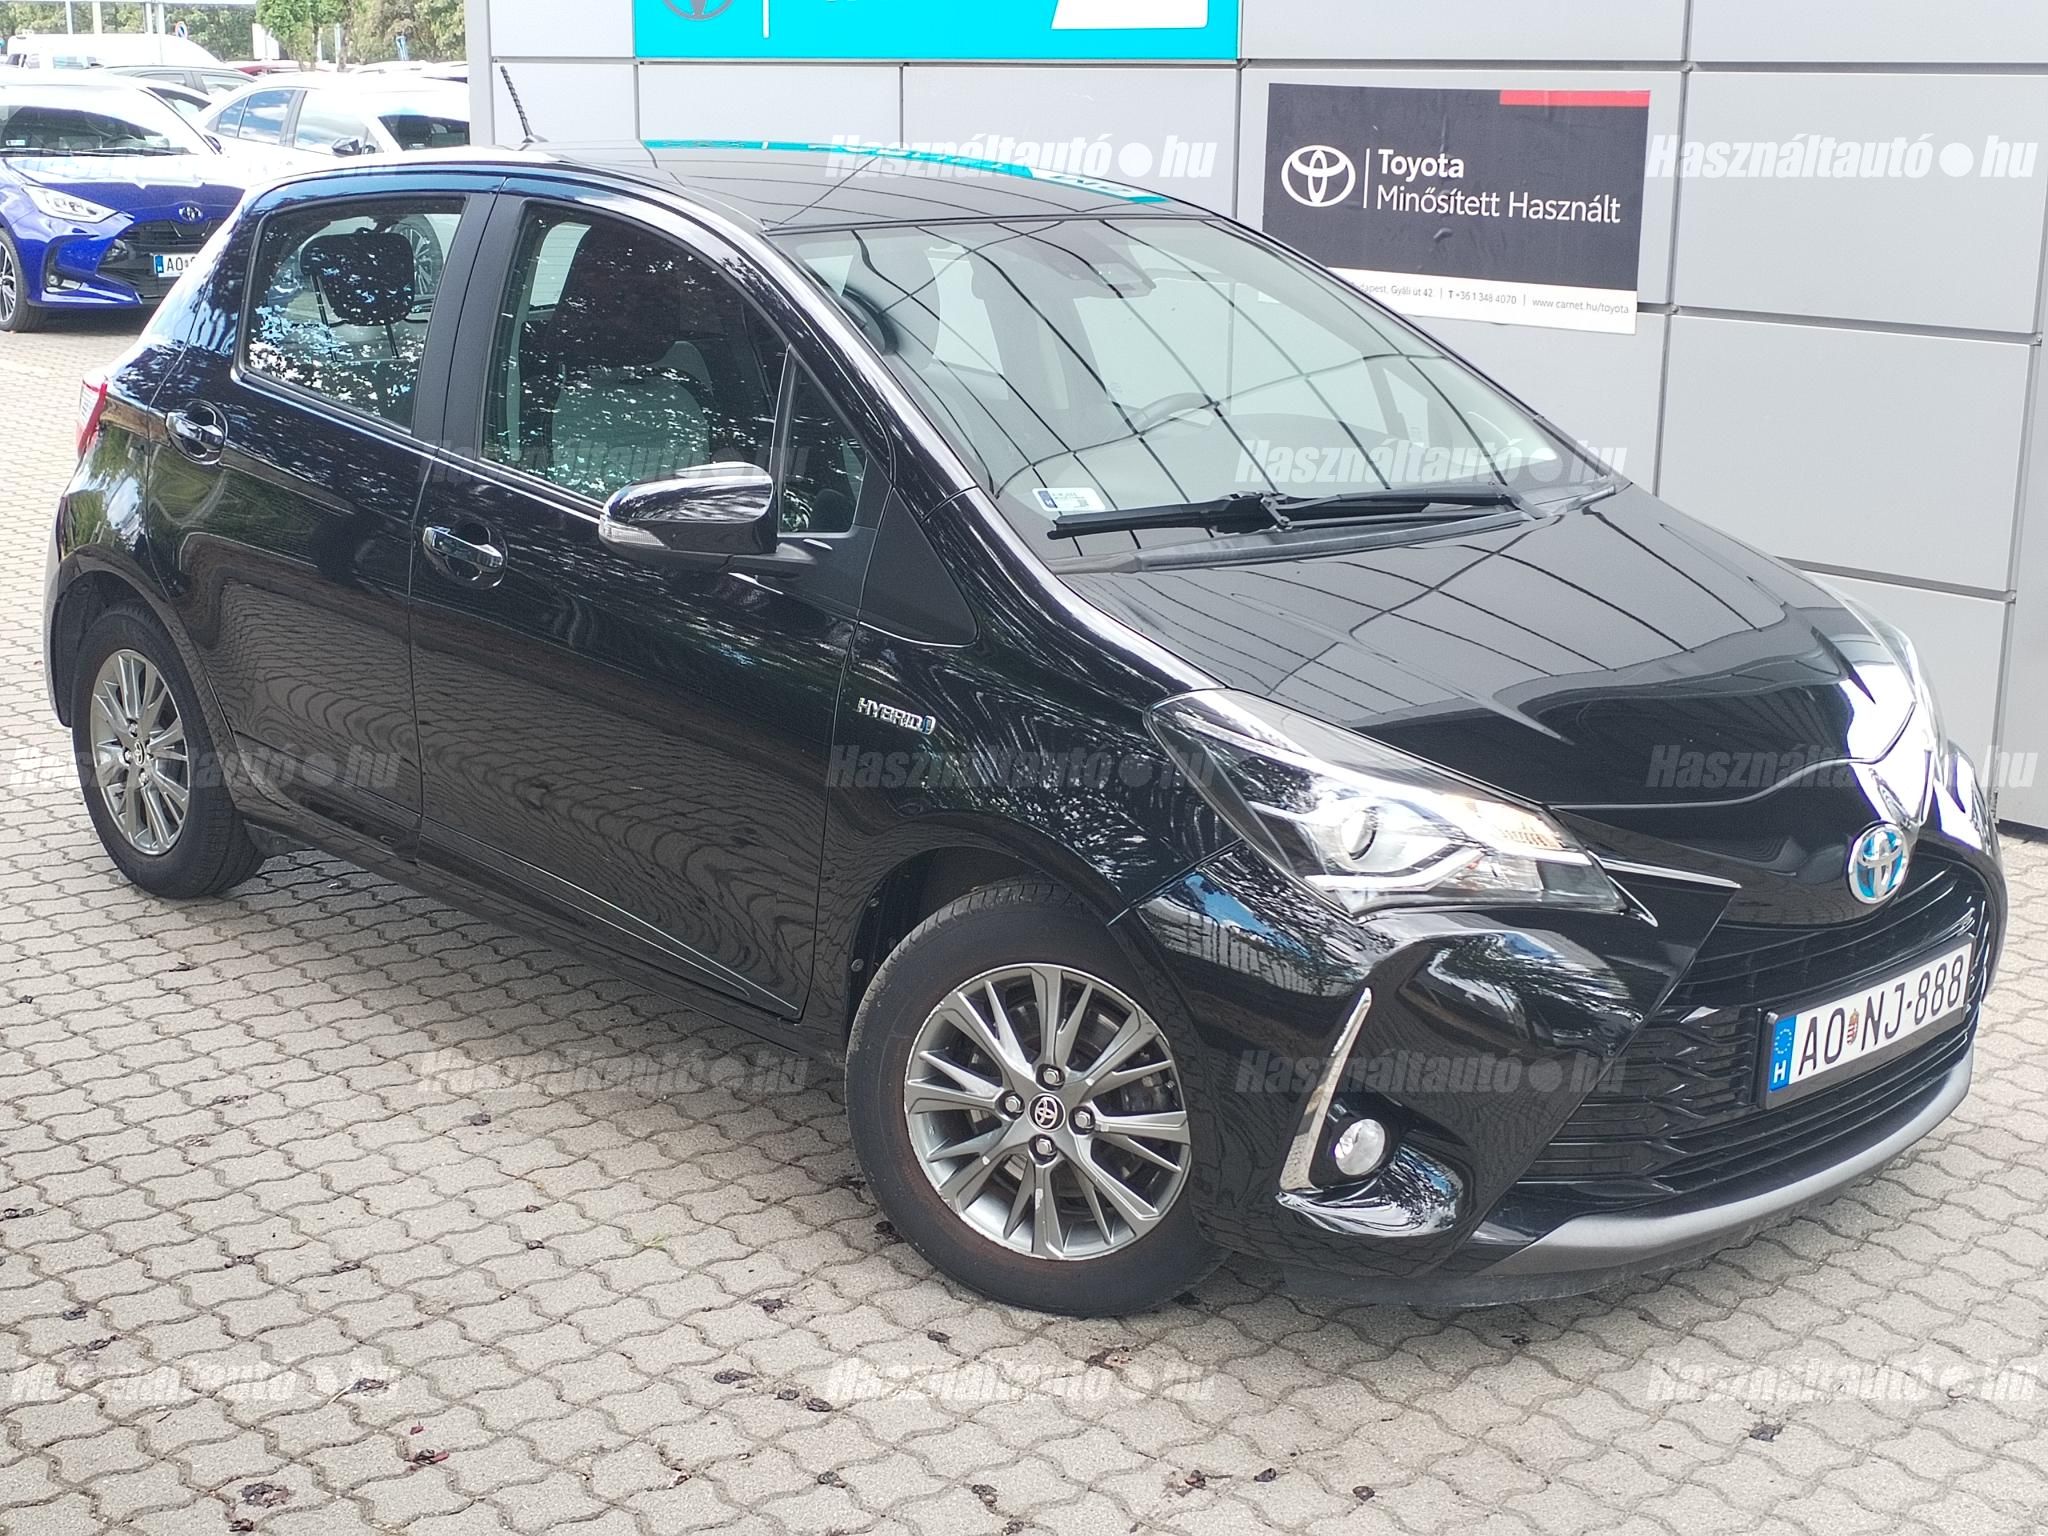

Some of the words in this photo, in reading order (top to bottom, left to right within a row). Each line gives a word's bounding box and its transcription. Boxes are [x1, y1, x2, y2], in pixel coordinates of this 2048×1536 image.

[1377, 148, 1465, 182] Toyota
[1377, 184, 1500, 217] Minősített
[1508, 191, 1621, 223] Használt
[1423, 287, 1433, 298] 42
[1448, 289, 1454, 299] T
[1455, 290, 1471, 301] +36
[1495, 294, 1517, 305] 4070
[1532, 298, 1630, 315] www.carnet.hu/toyota
[857, 697, 923, 731] HYBRID
[1773, 1059, 1787, 1083] H
